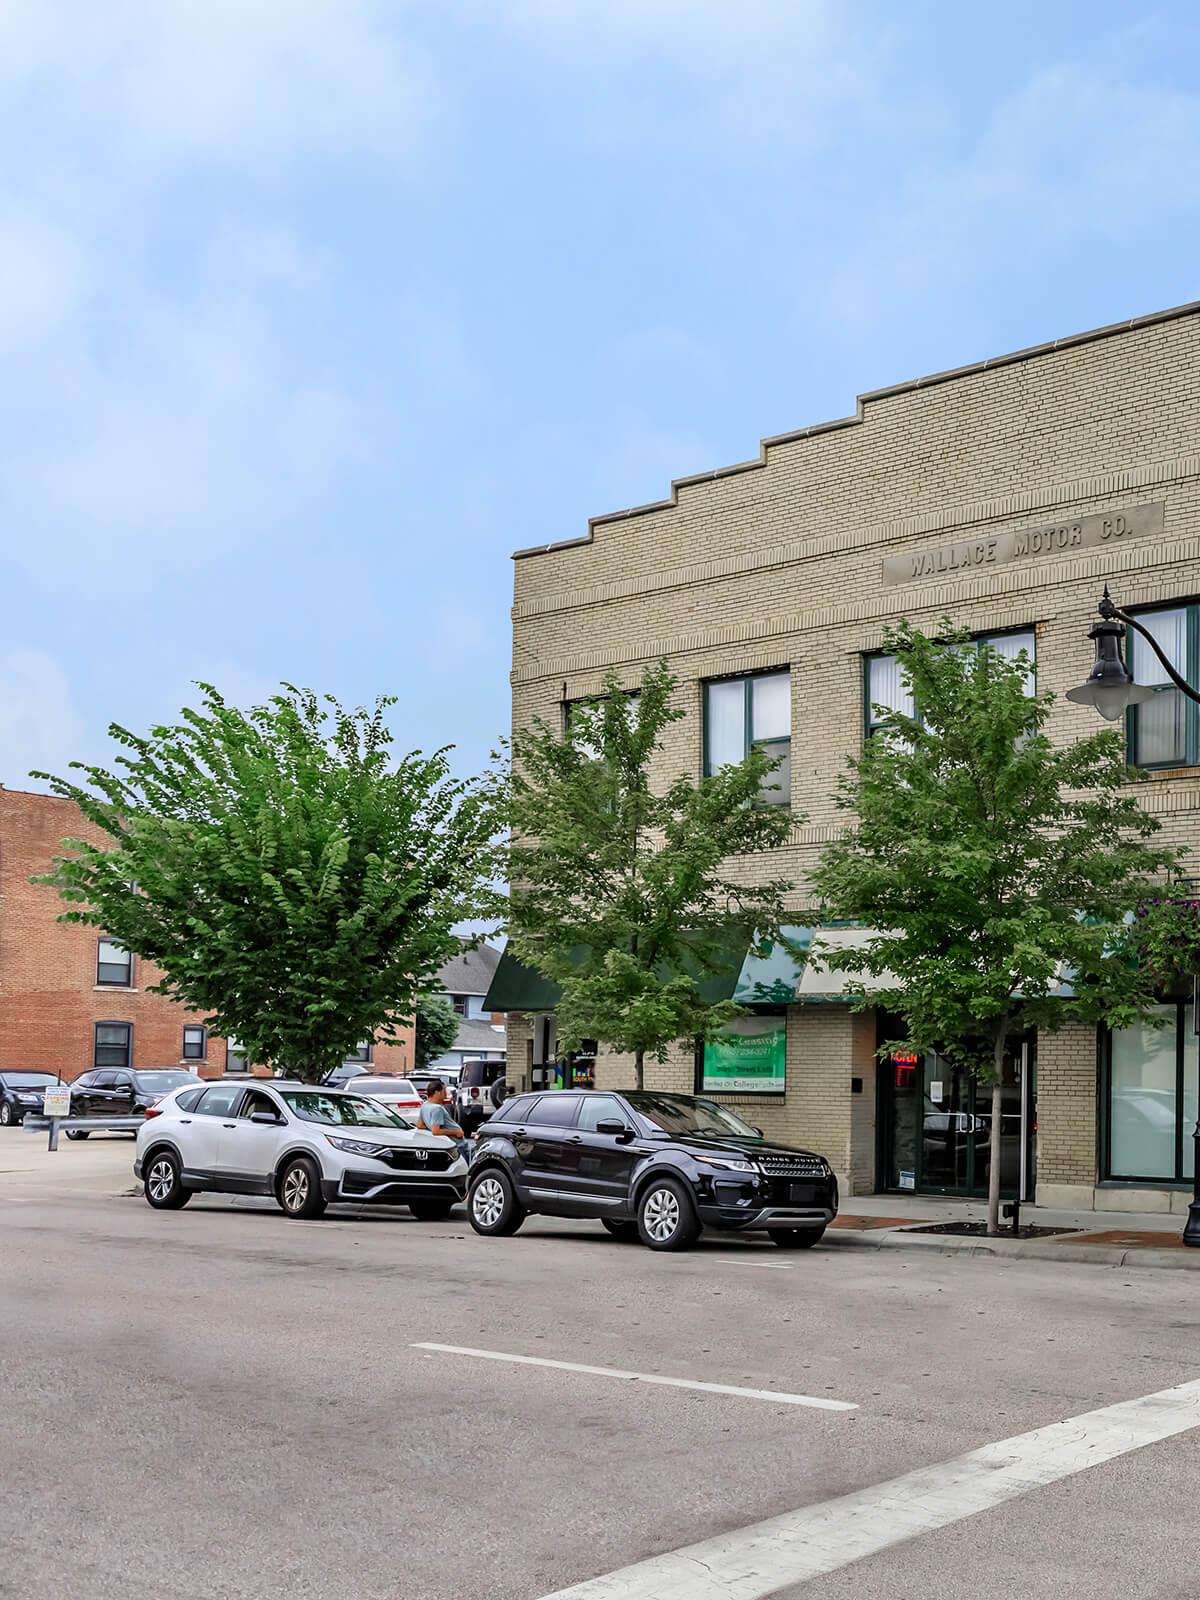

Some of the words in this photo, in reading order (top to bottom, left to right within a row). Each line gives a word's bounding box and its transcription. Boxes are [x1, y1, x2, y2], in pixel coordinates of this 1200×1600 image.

[910, 540, 998, 579] WALLACE
[1013, 523, 1082, 558] MOTOR
[1100, 514, 1133, 540] CO.
